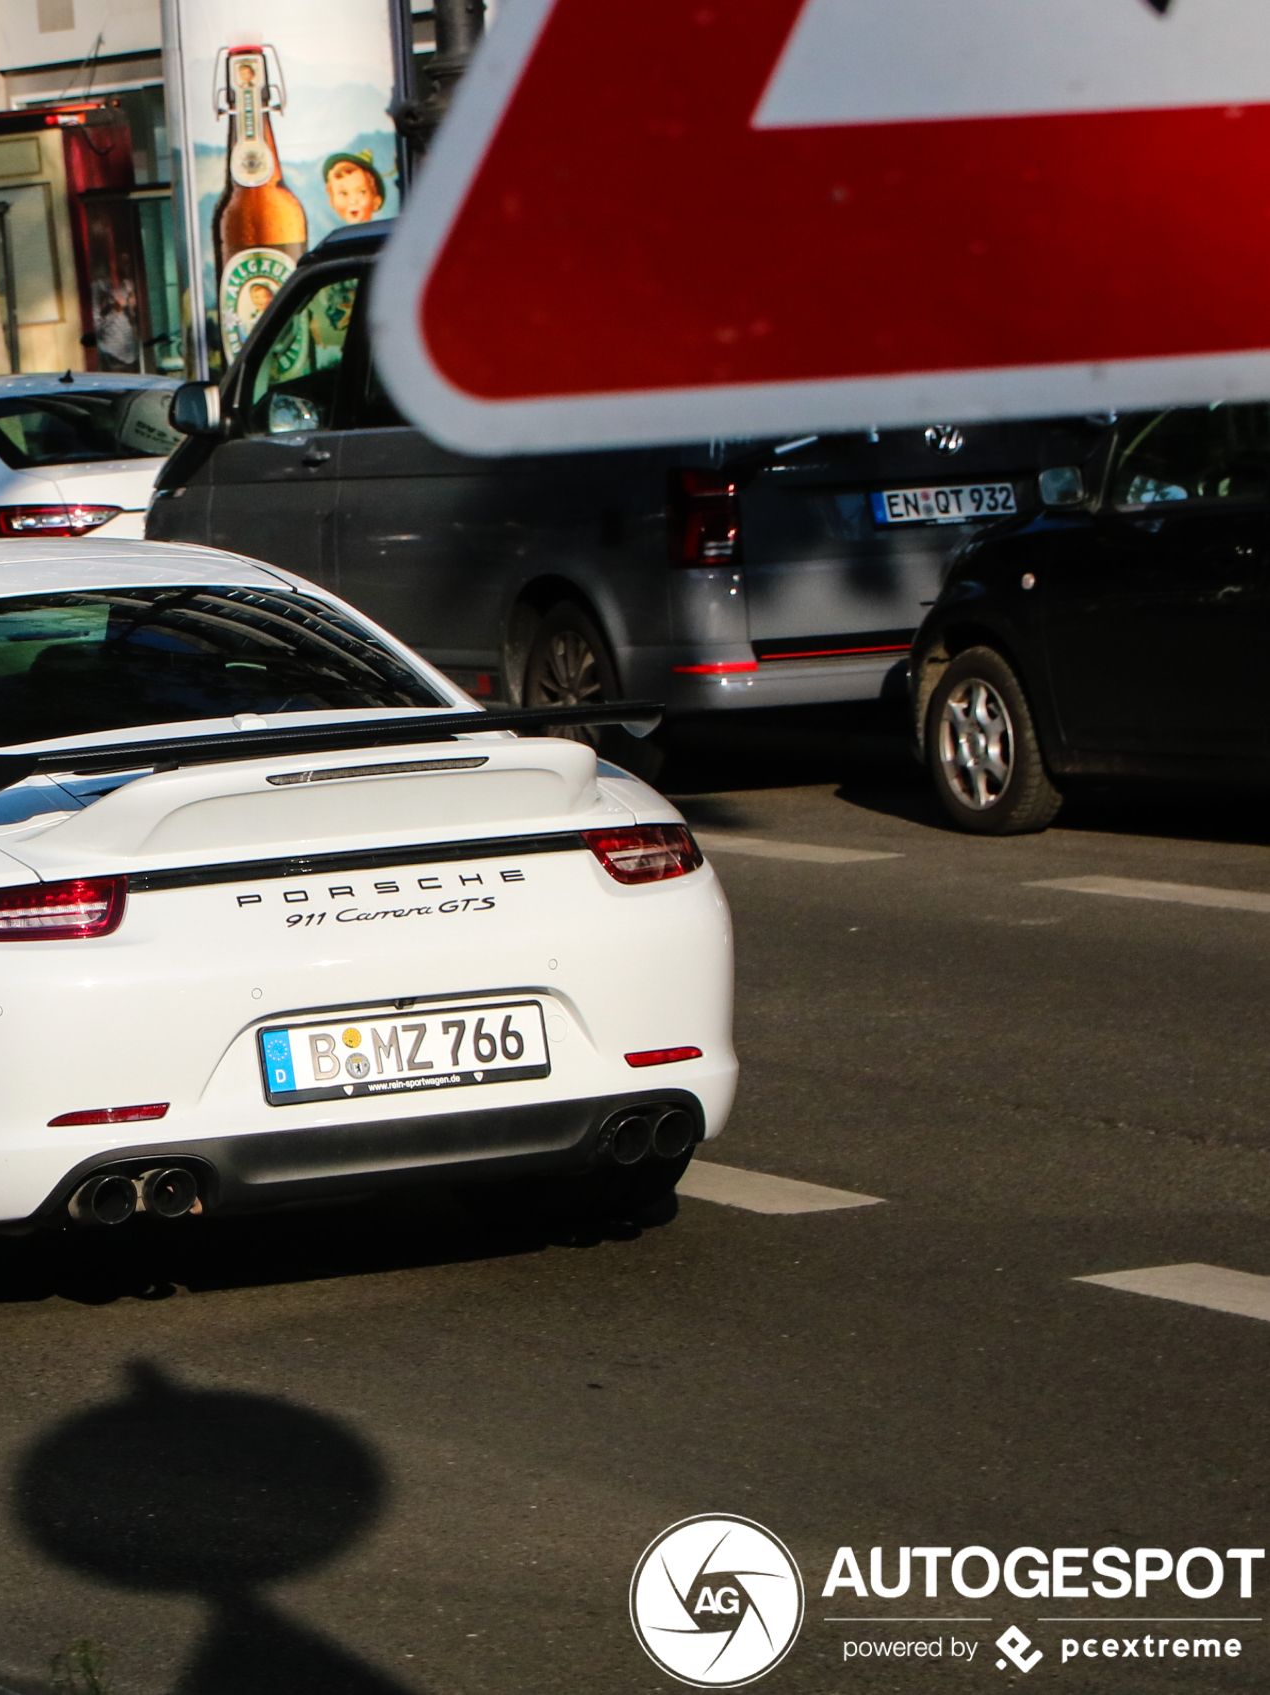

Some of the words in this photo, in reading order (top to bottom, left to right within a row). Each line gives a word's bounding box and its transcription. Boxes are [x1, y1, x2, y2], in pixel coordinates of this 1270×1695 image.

[228, 259, 292, 298] ALLGÄUE
[886, 493, 921, 519] EN
[935, 489, 964, 515] QT
[970, 486, 1014, 512] 932
[236, 869, 526, 907] PORSCHE
[285, 911, 328, 928] 911
[335, 907, 433, 923] Carrera
[438, 896, 497, 913] GTS
[275, 1068, 287, 1084] D
[308, 1033, 341, 1081] B
[370, 1023, 434, 1075] MZ
[441, 1014, 525, 1067] 766
[368, 1073, 462, 1092] www.rein-sportwagen.de
